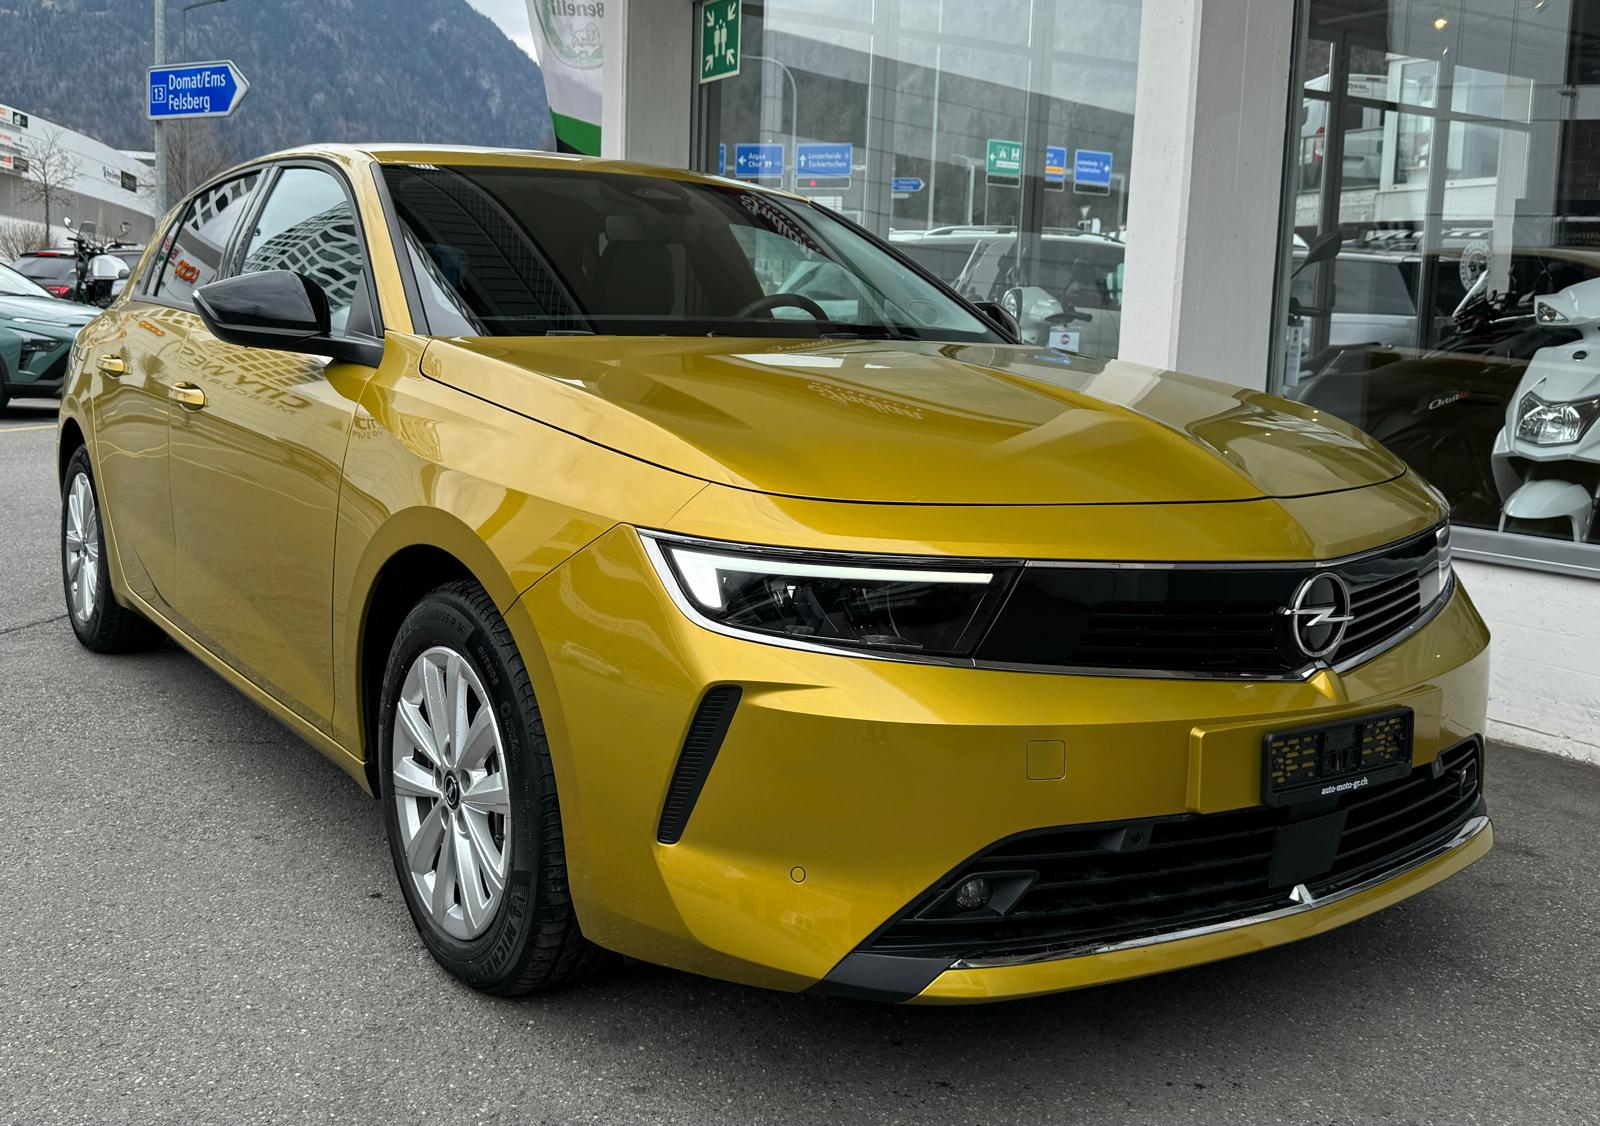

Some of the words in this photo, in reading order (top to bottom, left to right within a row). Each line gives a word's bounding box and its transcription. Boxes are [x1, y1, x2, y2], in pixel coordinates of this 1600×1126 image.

[168, 71, 226, 90] Domat/Ems
[154, 87, 164, 100] 13
[168, 92, 211, 112] Felsberg
[1321, 777, 1368, 795] auto-moto-gr.ch
